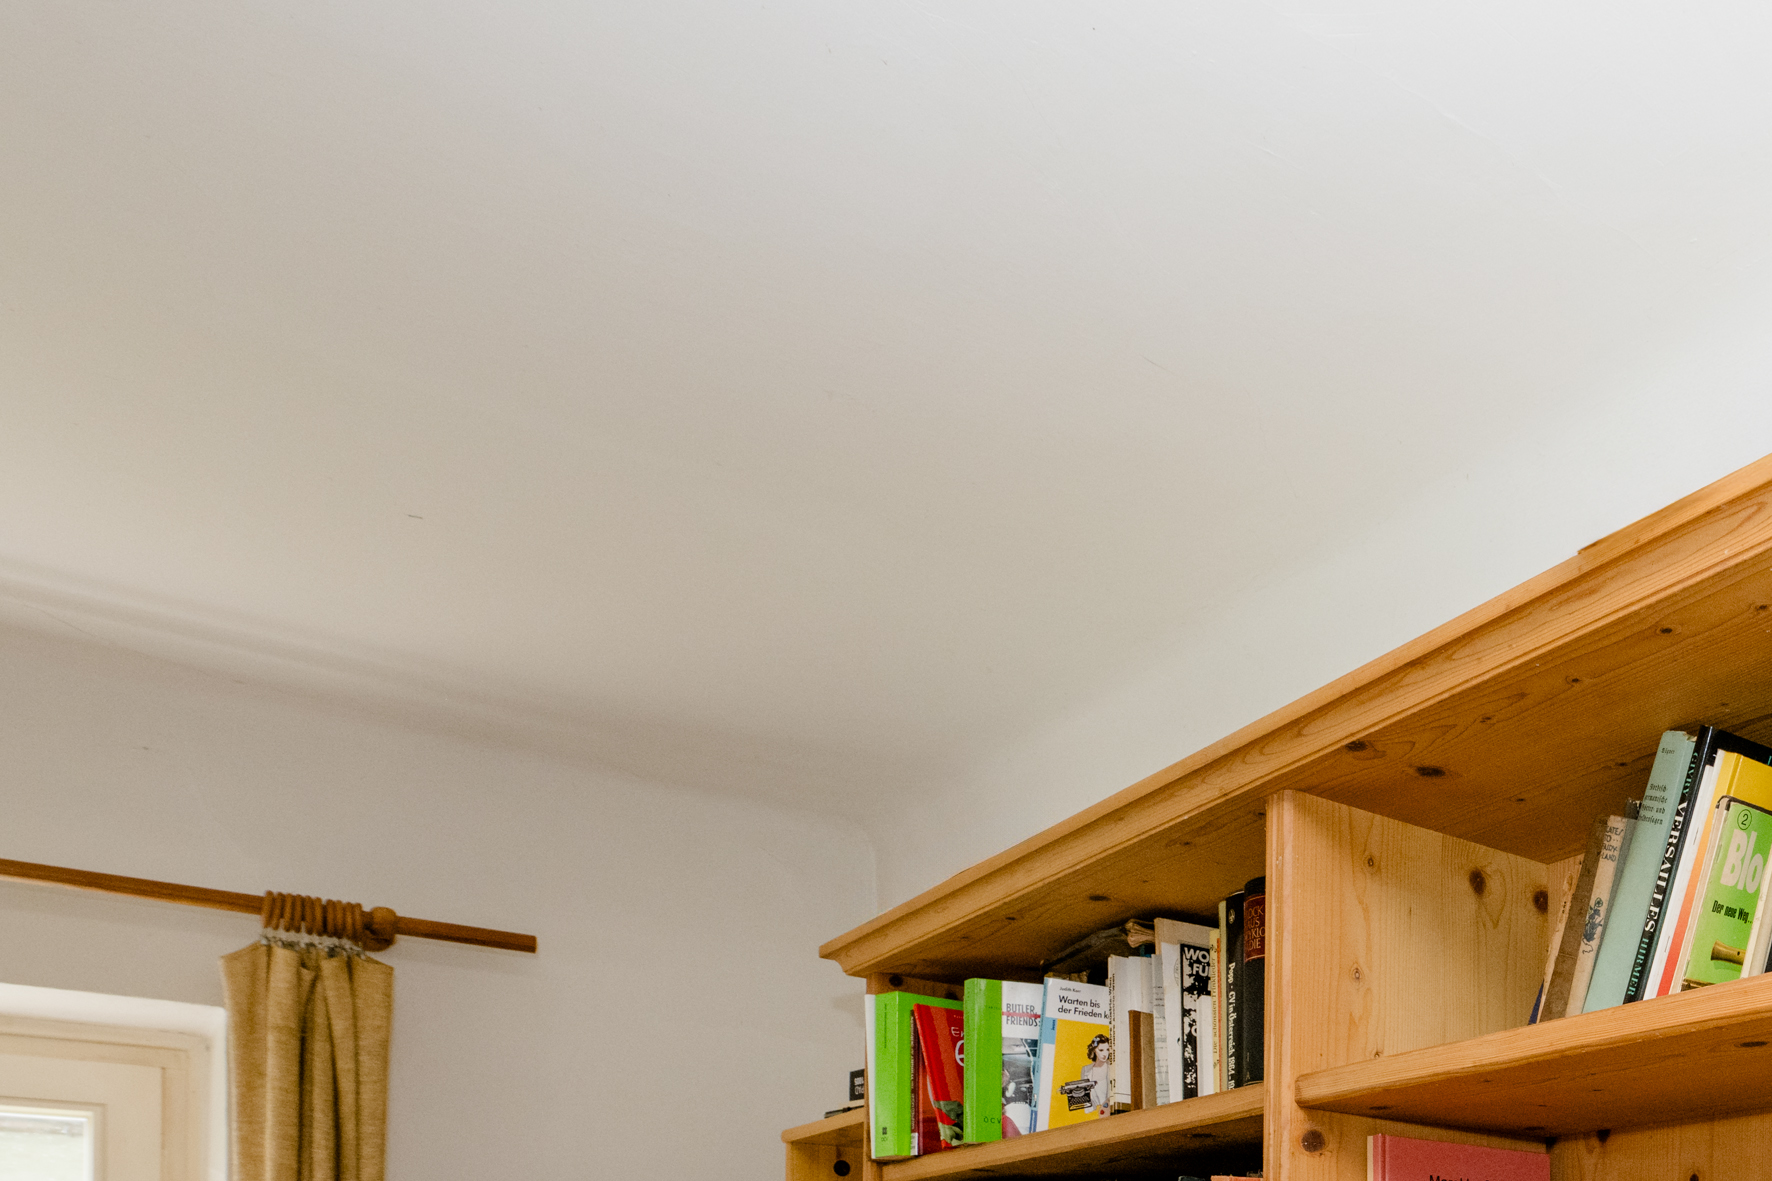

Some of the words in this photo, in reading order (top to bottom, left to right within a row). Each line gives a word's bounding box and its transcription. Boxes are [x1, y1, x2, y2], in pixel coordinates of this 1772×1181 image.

[1683, 751, 1699, 796] GIVRY
[1644, 801, 1688, 932] VERSAILLES
[1712, 900, 1725, 915] Der
[1724, 904, 1737, 918] neue
[1628, 938, 1649, 995] HIRMER
[1006, 1003, 1038, 1015] BUTLER,
[1058, 995, 1088, 1008] Warten
[1089, 999, 1100, 1008] bis
[1058, 1005, 1072, 1014] der
[1074, 1008, 1102, 1019] Frieden
